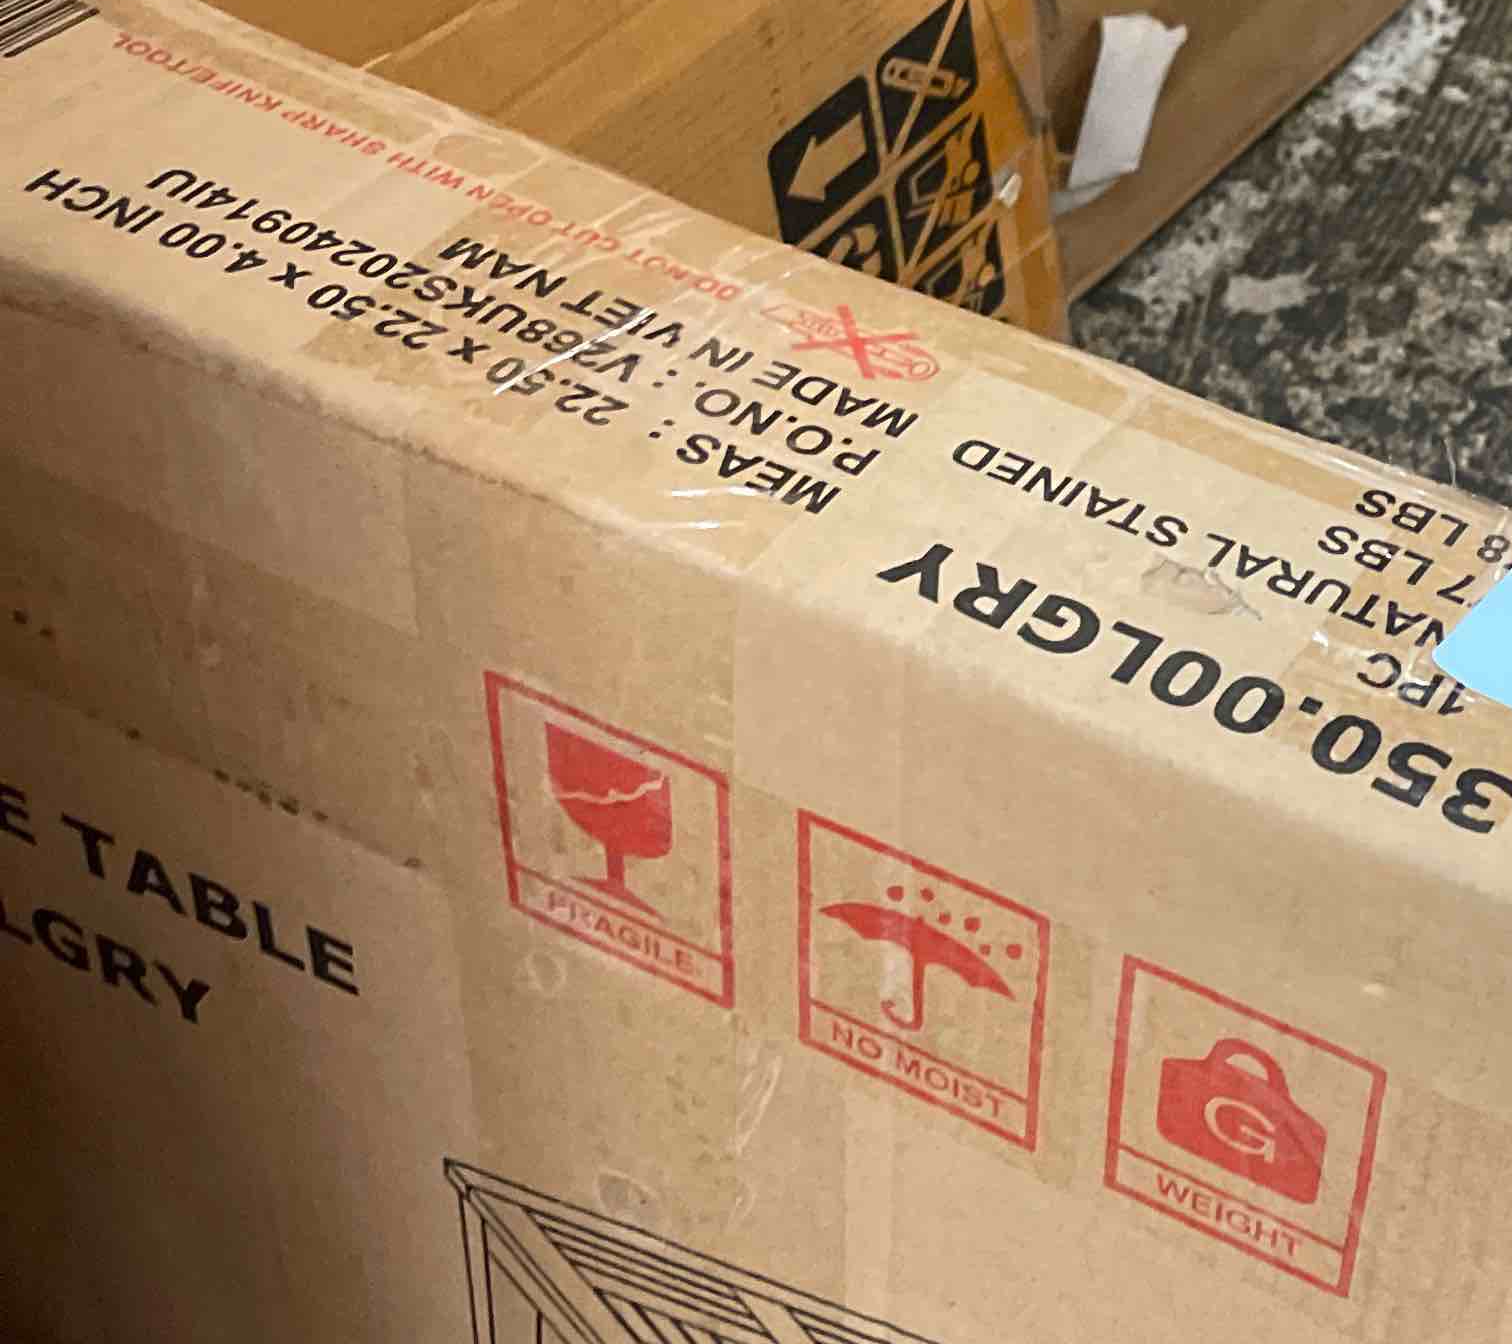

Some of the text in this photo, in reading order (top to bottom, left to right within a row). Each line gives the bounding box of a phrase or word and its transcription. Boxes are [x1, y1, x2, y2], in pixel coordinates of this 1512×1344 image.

[23, 168, 164, 235] INCH
[112, 31, 745, 303] DO NOT CUT OPEN WITH SHARP KNIFE/TOOL
[158, 223, 268, 275] 4.00
[306, 284, 449, 350] 22.50
[437, 236, 919, 440] MADE IN VIET NAM
[485, 356, 630, 427] 22.50
[951, 438, 1446, 645] NATURAL STAINED
[1355, 489, 1471, 547] LBS
[1316, 525, 1475, 607] 7 LBS
[1356, 652, 1466, 717] 1PC
[61, 811, 360, 996] TABLE
[545, 890, 696, 975] FRAGILE
[831, 1020, 1007, 1122] NO MOIST
[1154, 1171, 1303, 1257] WEIGHT
